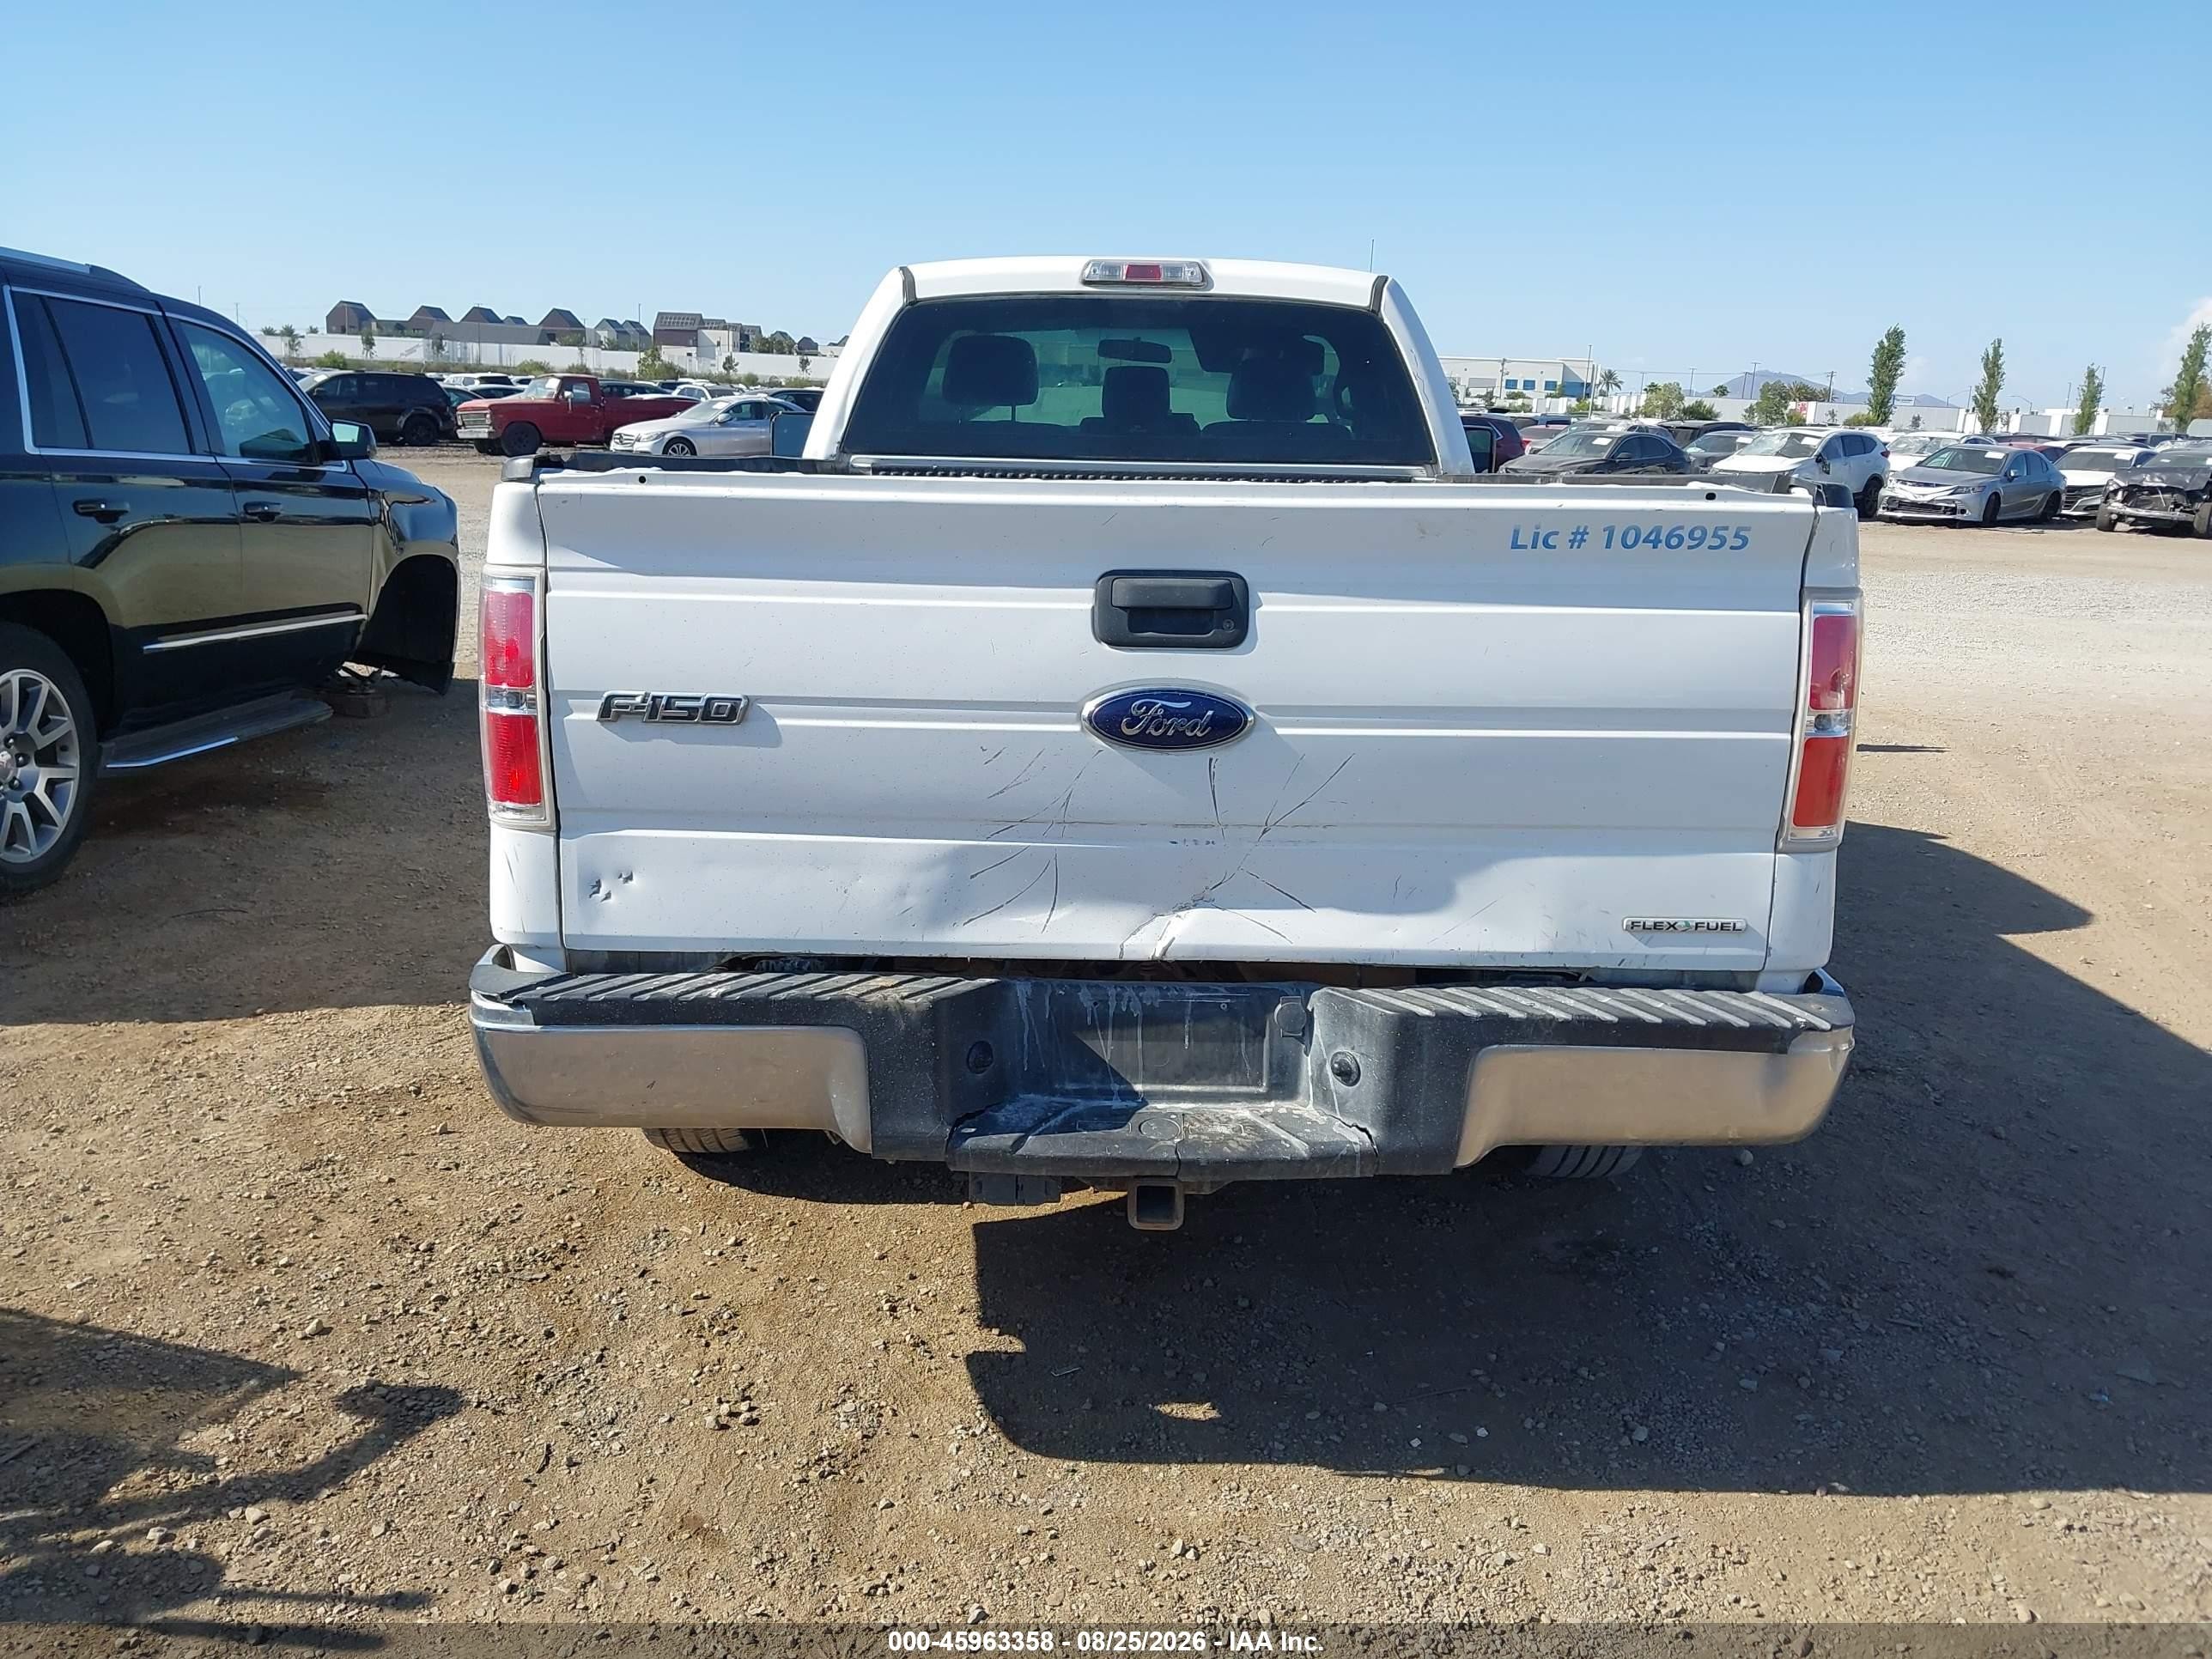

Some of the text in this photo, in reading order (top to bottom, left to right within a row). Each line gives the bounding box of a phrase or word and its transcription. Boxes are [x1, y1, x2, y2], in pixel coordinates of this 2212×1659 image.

[1510, 525, 1751, 550] Lic # 1046955
[1121, 698, 1214, 737] Ford
[1631, 921, 1742, 932] FLEX FUEL
